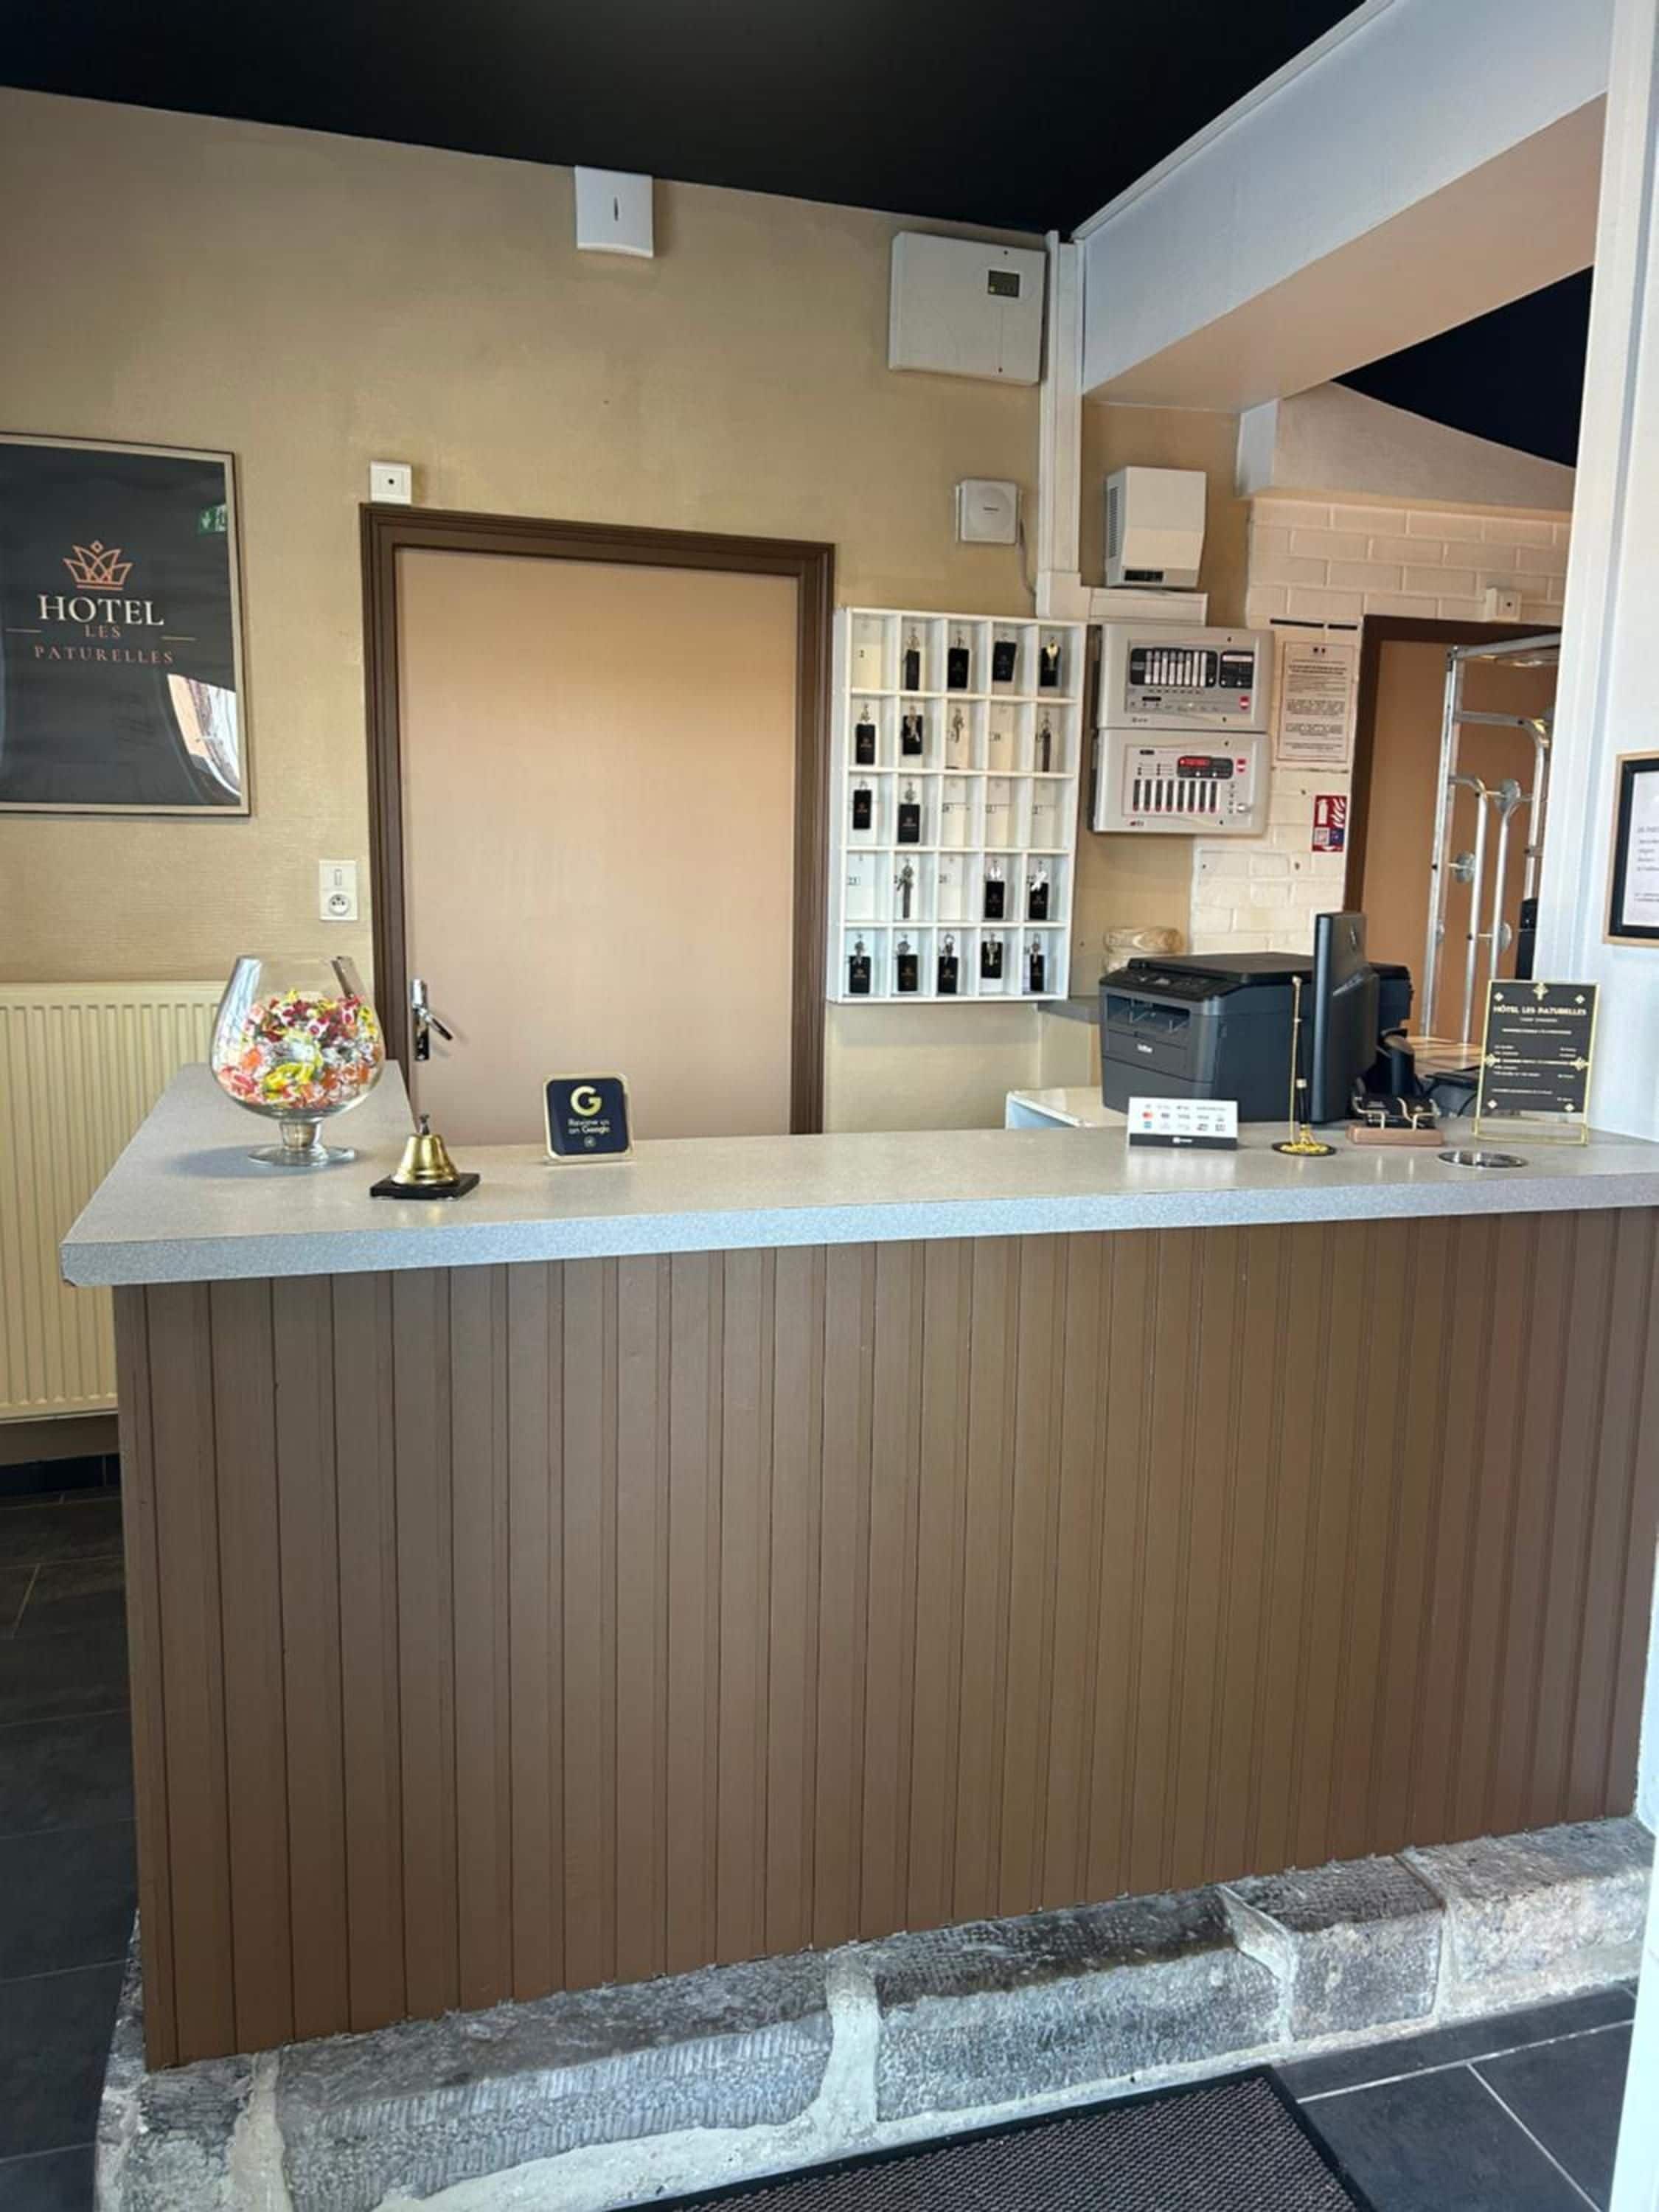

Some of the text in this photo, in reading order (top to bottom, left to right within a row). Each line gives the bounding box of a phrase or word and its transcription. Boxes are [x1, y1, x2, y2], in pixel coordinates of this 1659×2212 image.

[38, 594, 164, 626] HOTEL
[85, 625, 121, 639] LES
[35, 645, 174, 664] PATURELLES
[1493, 1004, 1519, 1014] HÔTEL
[1521, 1006, 1536, 1014] LES
[571, 1085, 602, 1116] G
